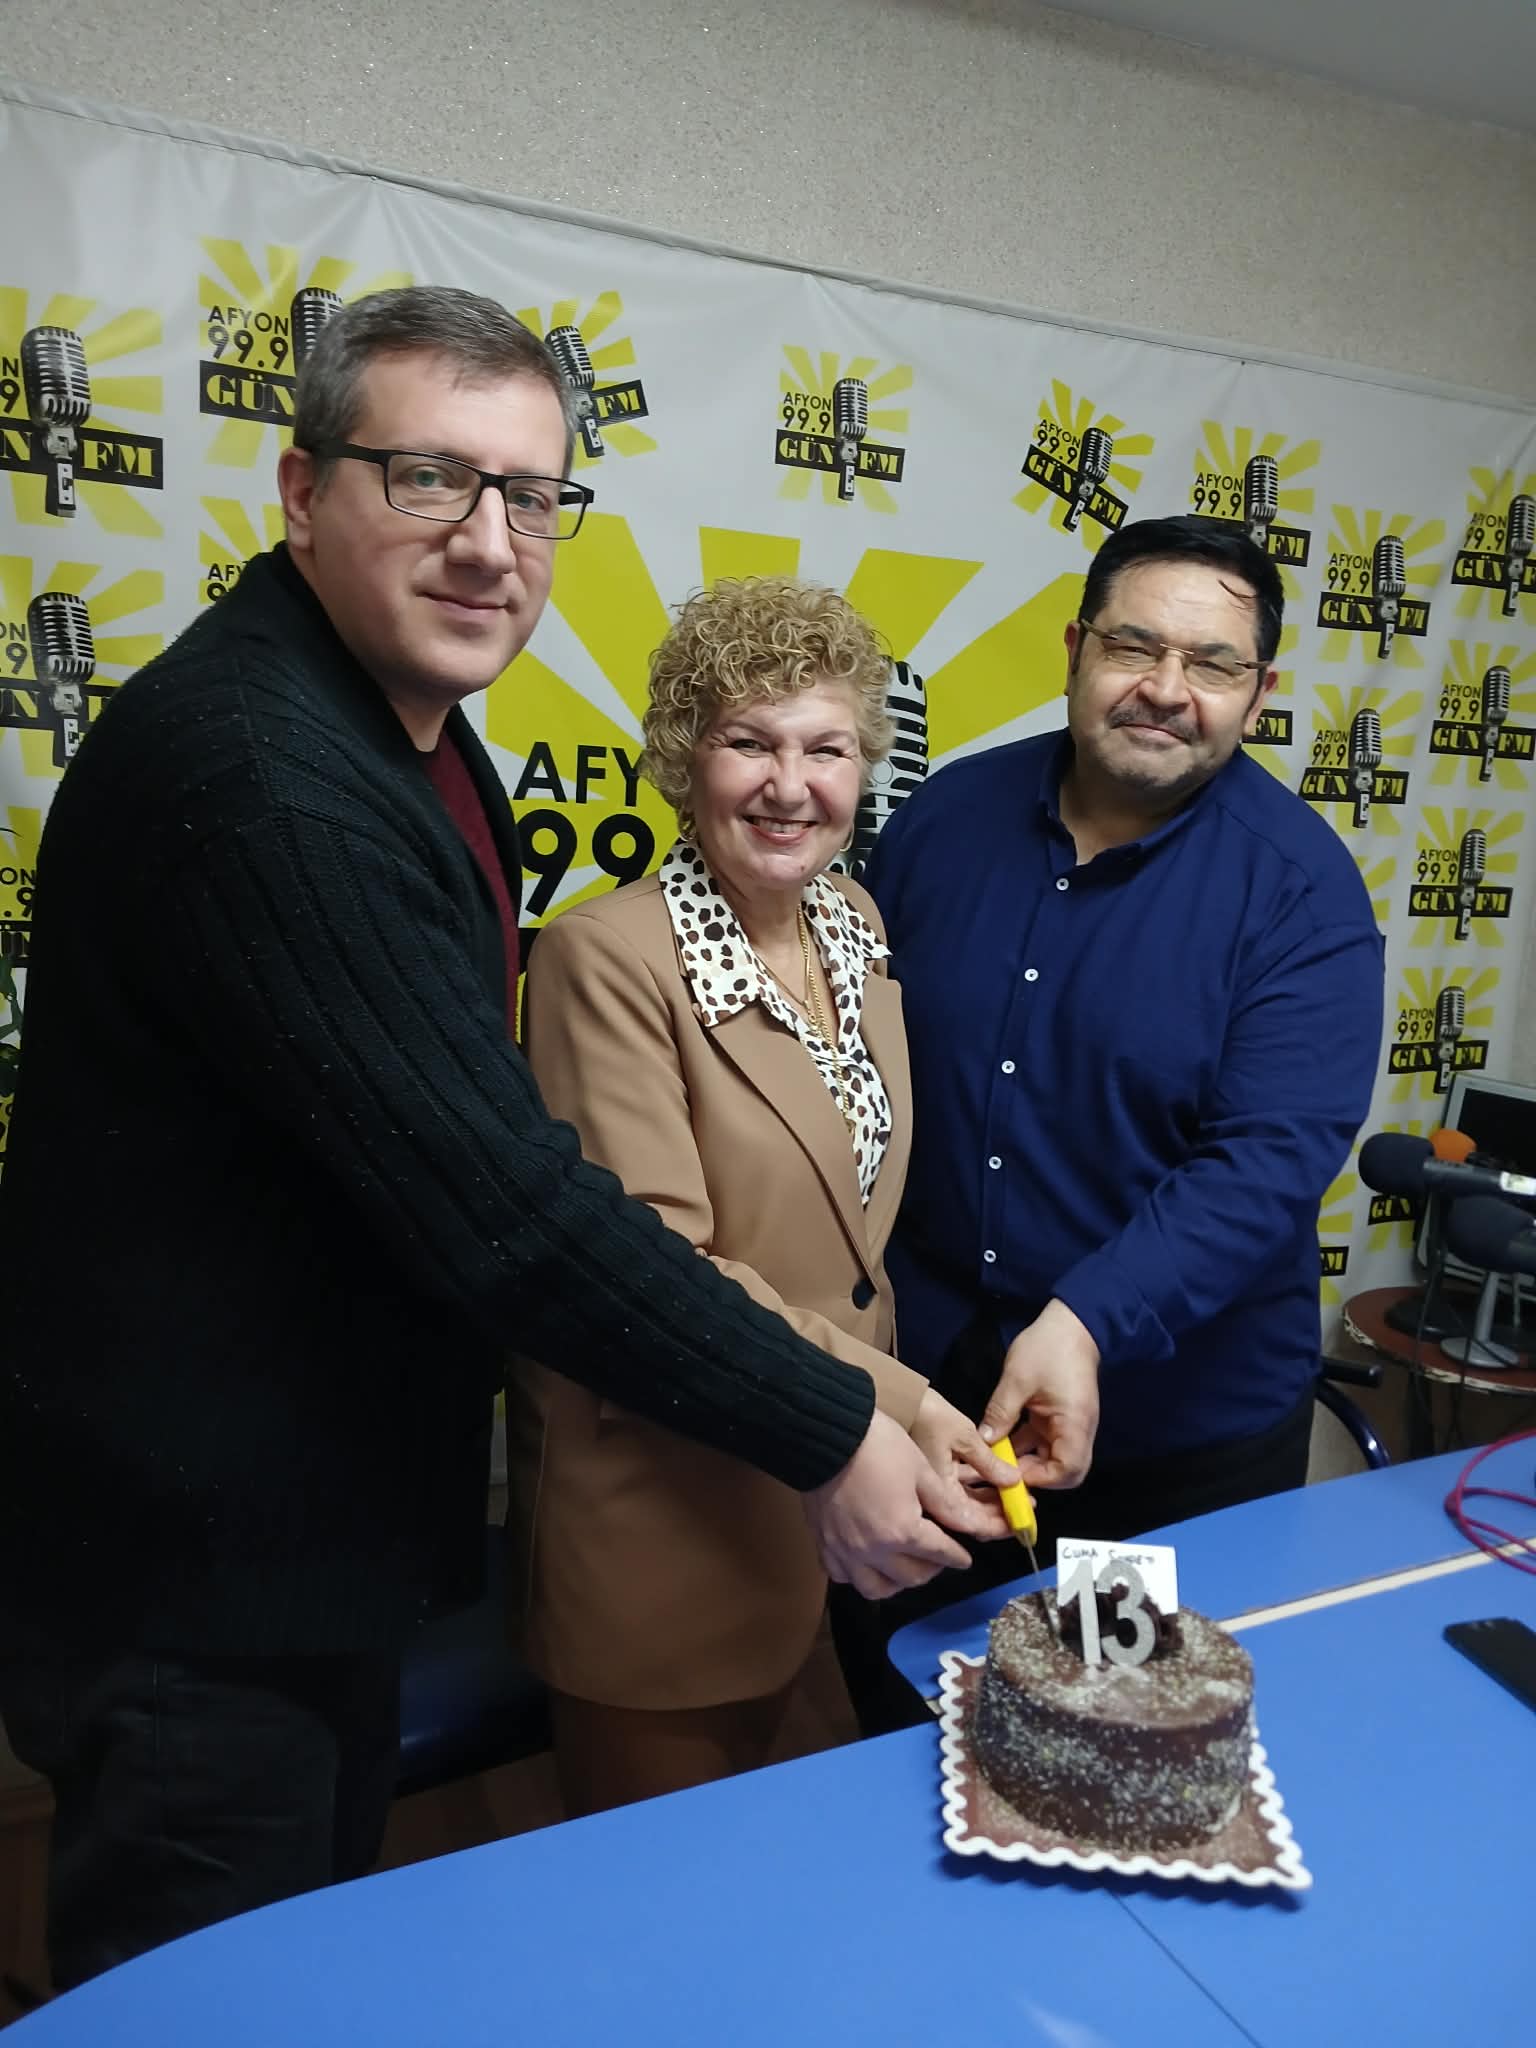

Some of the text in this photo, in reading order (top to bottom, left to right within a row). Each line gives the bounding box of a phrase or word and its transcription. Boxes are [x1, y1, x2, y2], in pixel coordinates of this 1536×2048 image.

[207, 304, 289, 337] AFYON
[207, 325, 289, 371] 99.9
[592, 389, 641, 418] FM
[783, 391, 832, 411] AFYON
[783, 405, 831, 434] 99.9
[1037, 429, 1078, 465] 99.9
[1040, 419, 1081, 449] AFYON
[80, 438, 157, 478] FM
[779, 437, 899, 475] GÜN FM
[1028, 454, 1123, 525] GÜN FM
[1195, 472, 1244, 492] AFYON
[1193, 487, 1242, 517] 99.9
[1267, 533, 1305, 559] FM
[1329, 552, 1373, 570] AFYON
[1455, 555, 1505, 582] GÜN
[1327, 567, 1370, 594] 99.9
[1322, 598, 1375, 625] GÜN
[1441, 684, 1482, 699] AFYON
[1440, 697, 1480, 721] 99.9
[1315, 729, 1349, 743] AFYON
[1433, 725, 1533, 753] GÜN FM
[1311, 743, 1347, 766] 99.9
[513, 741, 645, 807] AFY
[516, 808, 655, 918] 99
[1418, 849, 1460, 862] AFYON
[1417, 862, 1458, 884] 99.9
[1399, 1008, 1436, 1021] AFYON
[1397, 1020, 1433, 1041] 99.9
[1056, 1559, 1156, 1668] 13
